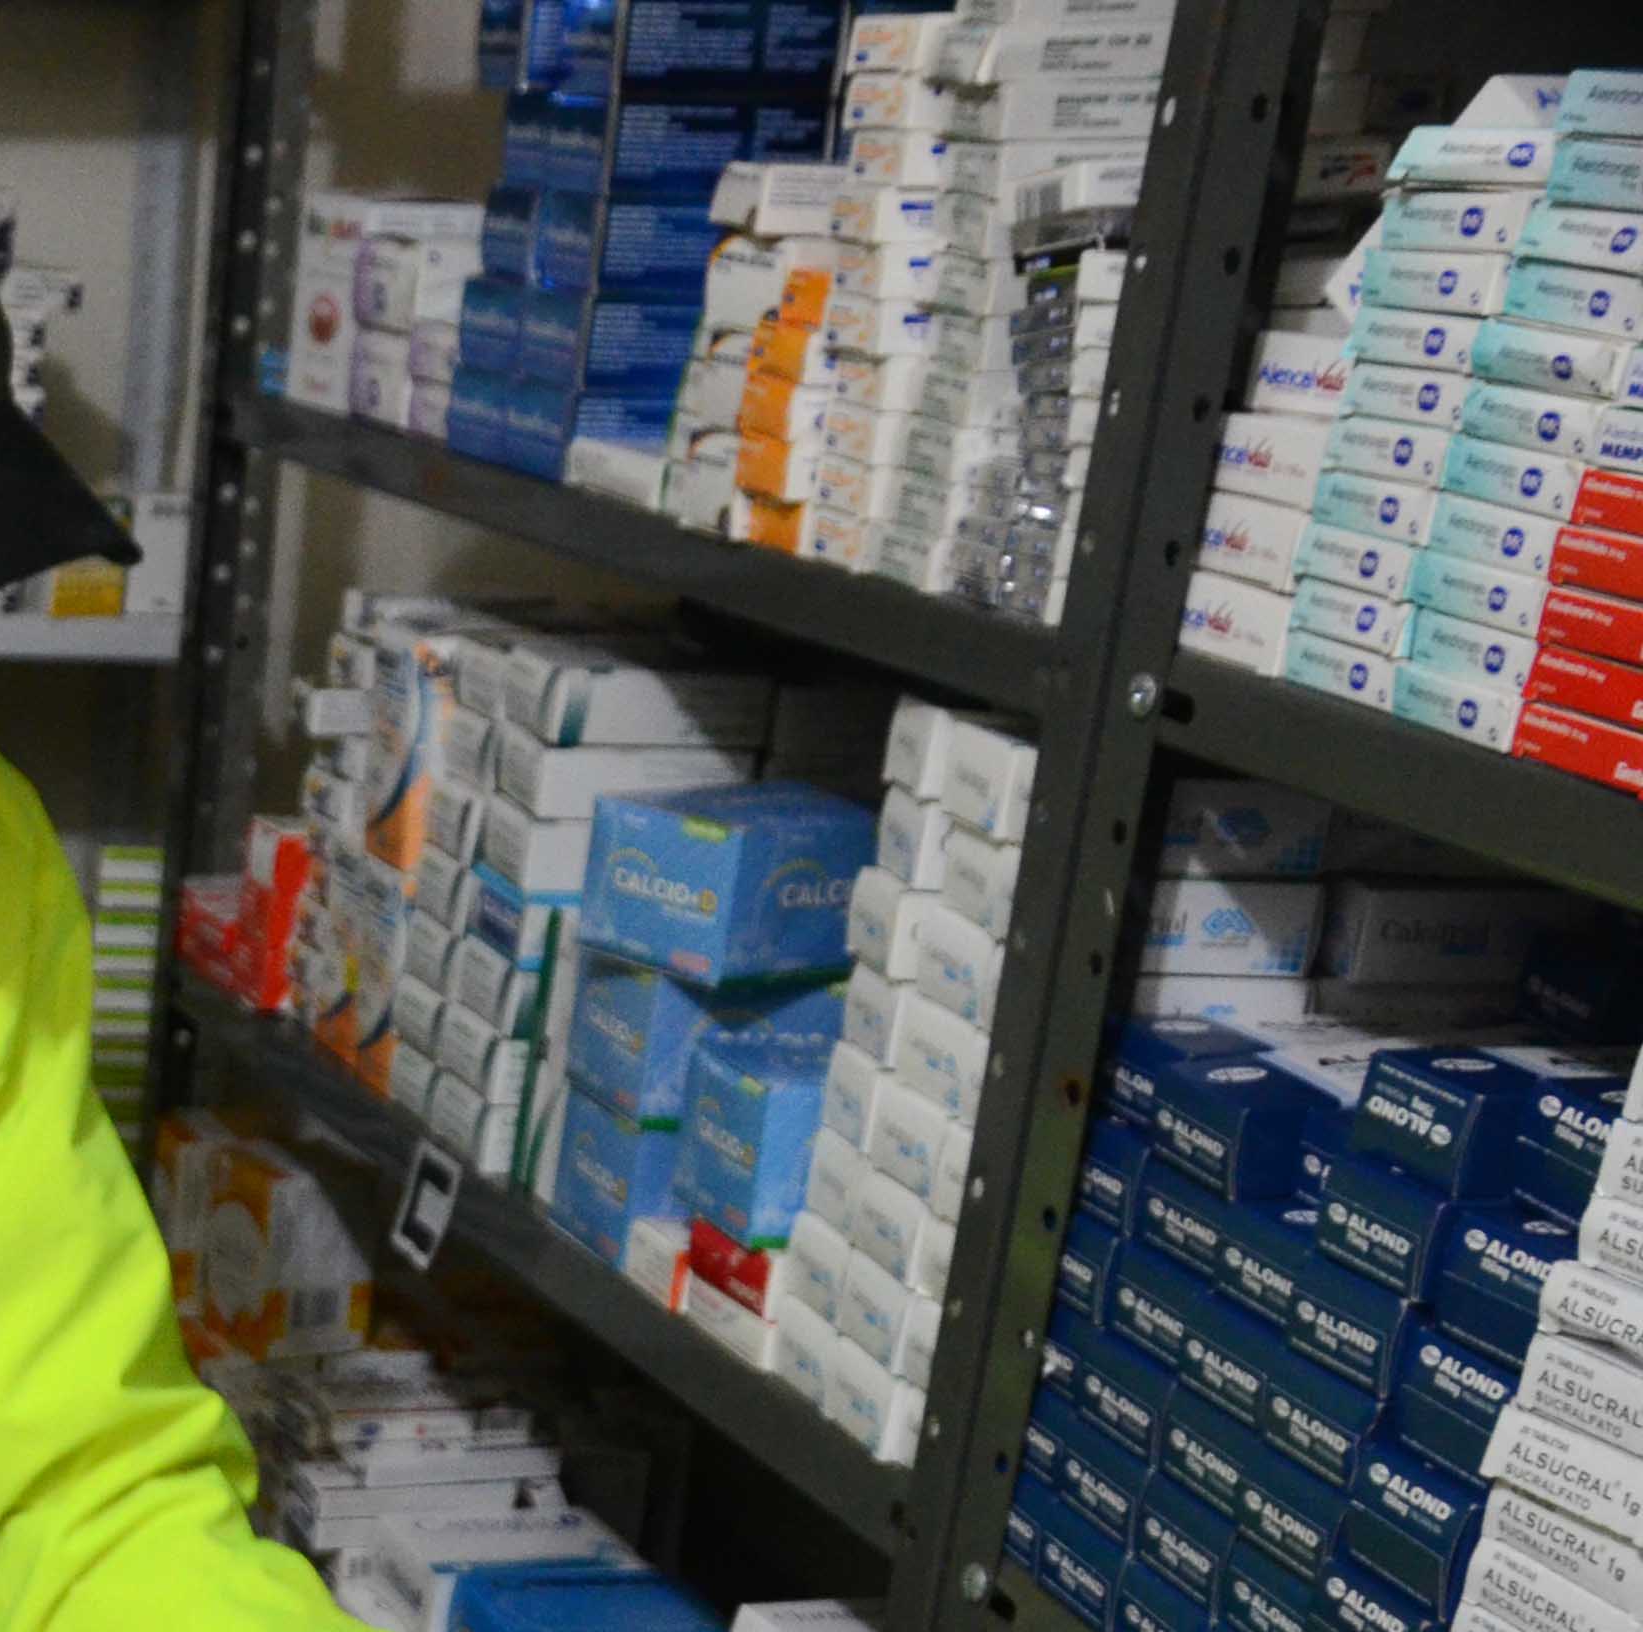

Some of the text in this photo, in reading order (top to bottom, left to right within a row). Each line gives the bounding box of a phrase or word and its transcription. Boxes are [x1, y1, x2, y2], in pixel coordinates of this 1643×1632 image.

[1115, 1066, 1154, 1096] ALON
[1173, 1119, 1225, 1158] ALOND
[1560, 1105, 1613, 1143] ALON
[1164, 1207, 1218, 1246] ALOND
[1345, 1213, 1412, 1256] ALOND
[1316, 1310, 1379, 1353] ALOND
[1203, 1350, 1260, 1393] ALOND
[1439, 1355, 1509, 1401] ALOND
[1100, 1386, 1151, 1428] ALOND
[1535, 1391, 1623, 1439] SUCRALFATO
[1537, 1370, 1643, 1429] ALSUCRAL
[1290, 1407, 1350, 1454] ALOND
[1186, 1442, 1238, 1485] ALOND
[1509, 1441, 1642, 1518] ALSUCRAL 1g
[1080, 1471, 1128, 1513] ALOND
[1387, 1473, 1455, 1521] ALOND
[1504, 1463, 1592, 1512] SUCRALFATO
[1263, 1502, 1320, 1548] ALOND
[1499, 1499, 1627, 1583] ALSUCRAL 1g
[1160, 1531, 1212, 1575] ALOND
[1058, 1557, 1106, 1599] ALOND
